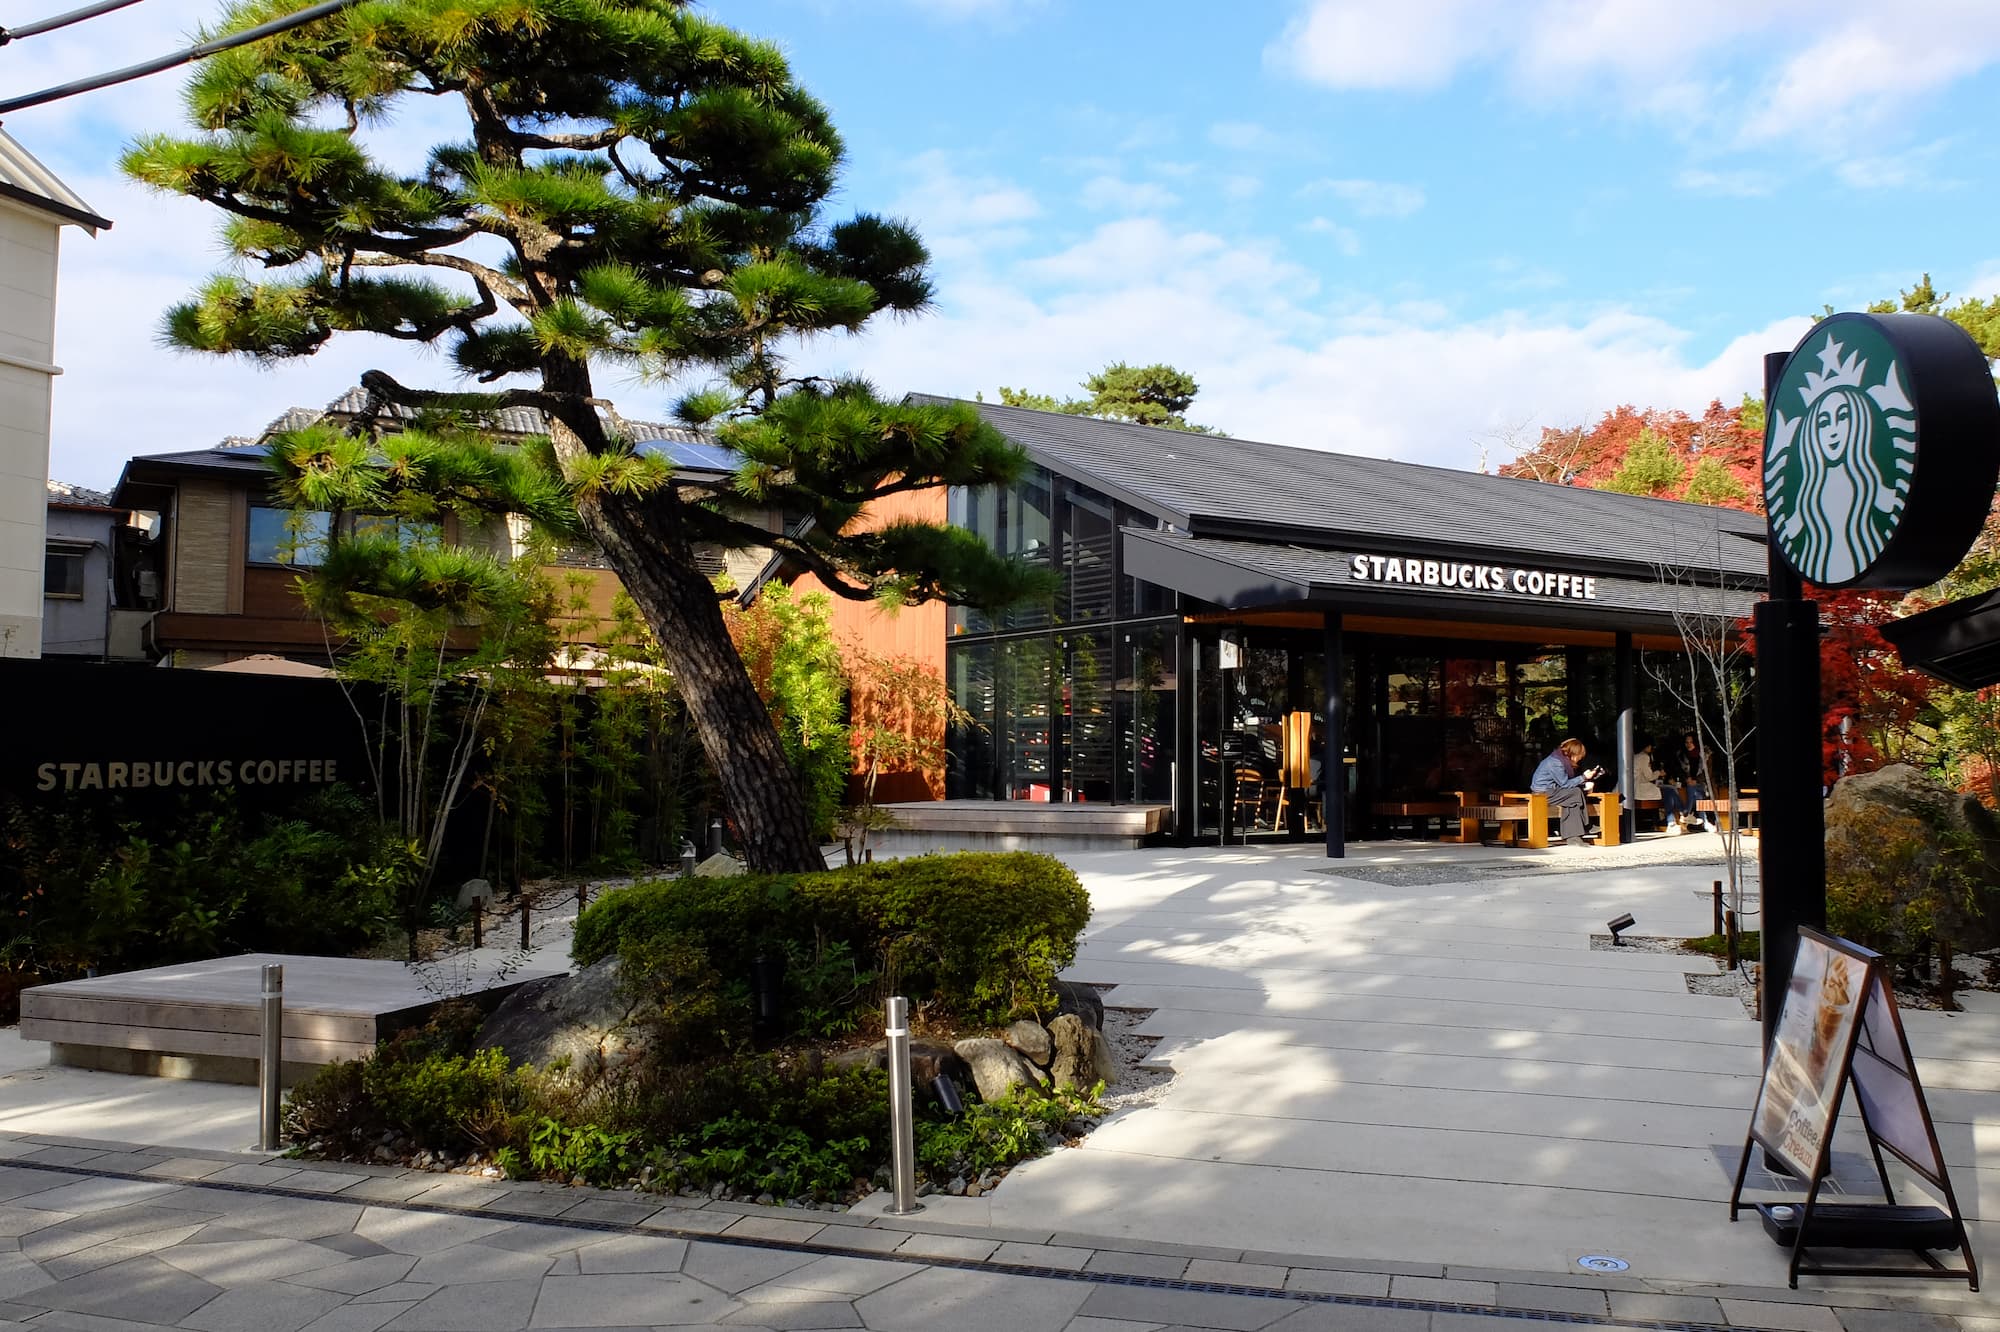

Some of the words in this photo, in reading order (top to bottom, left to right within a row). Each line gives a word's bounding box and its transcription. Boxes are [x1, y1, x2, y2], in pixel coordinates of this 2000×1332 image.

[1353, 554, 1505, 591] STARBUCKS
[1512, 569, 1596, 599] COFFEE
[36, 761, 234, 791] STARBUCKS
[239, 759, 337, 784] COFFEE
[1789, 1110, 1818, 1146] Coffee
[1784, 1130, 1813, 1169] Cream
